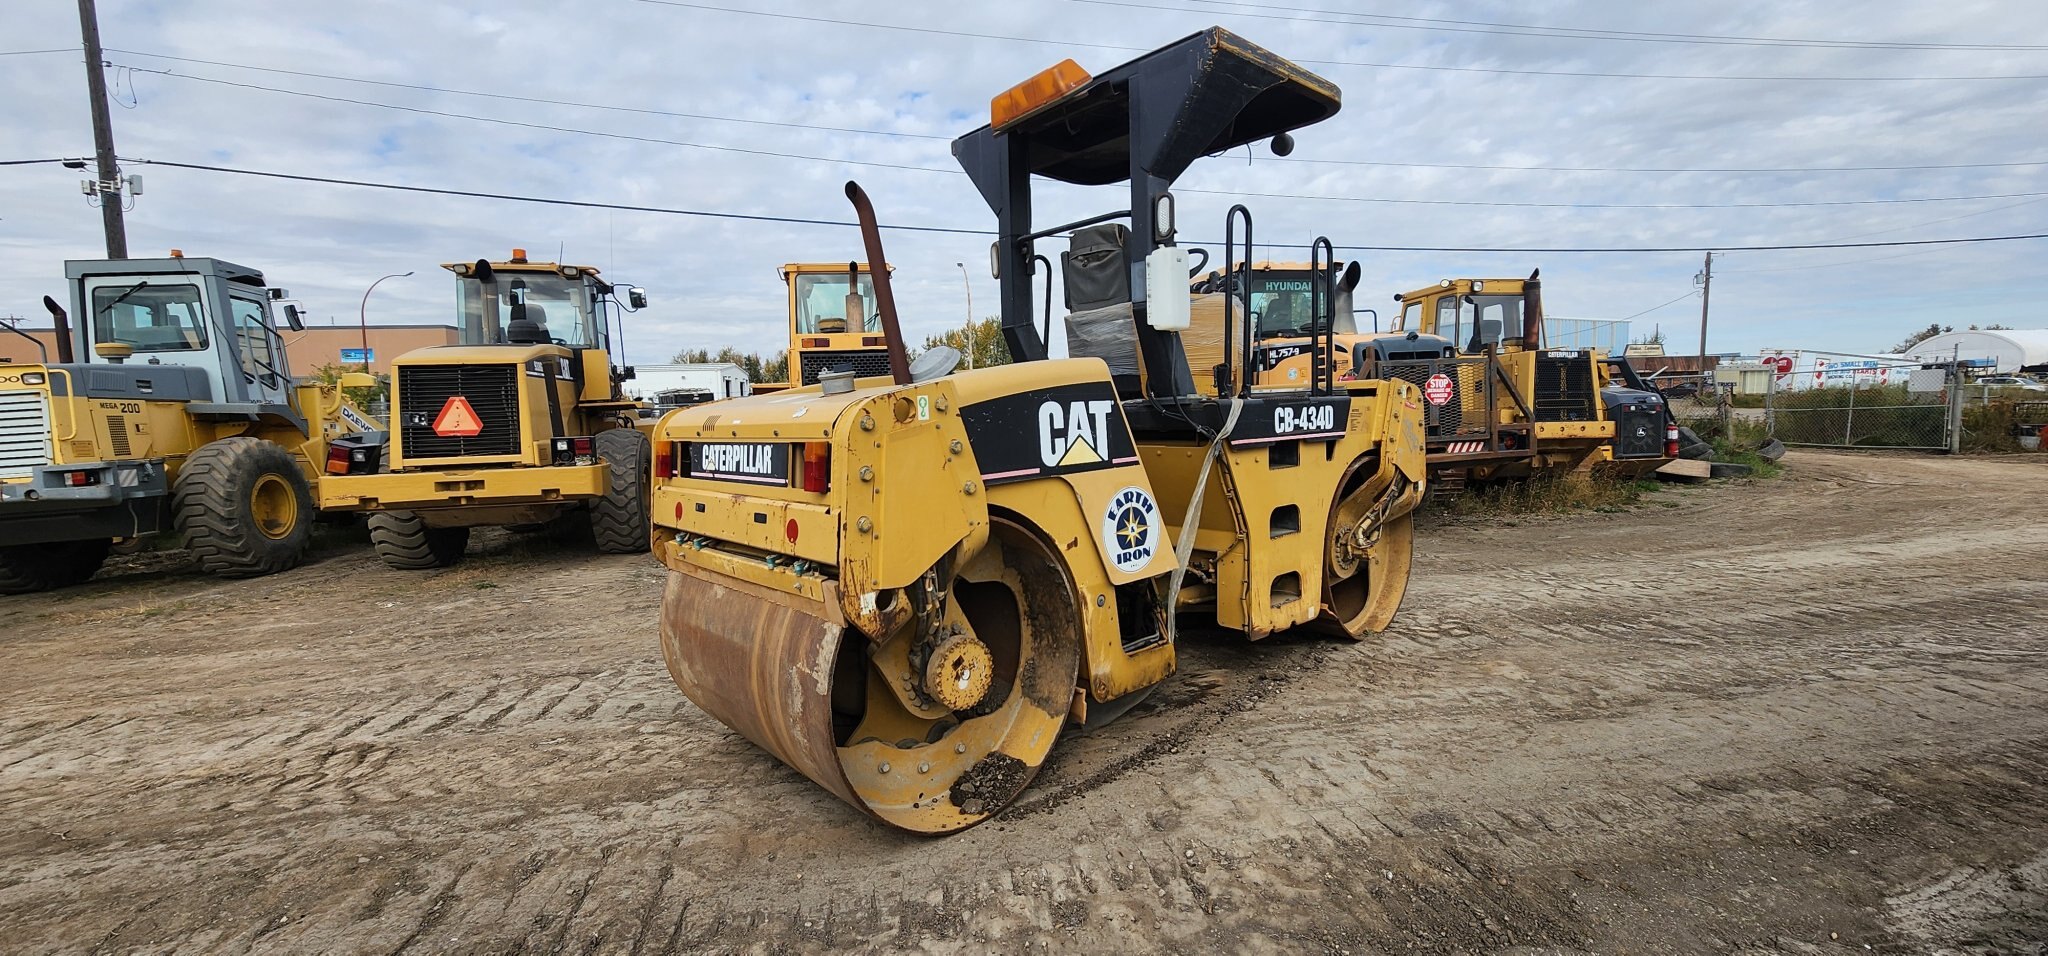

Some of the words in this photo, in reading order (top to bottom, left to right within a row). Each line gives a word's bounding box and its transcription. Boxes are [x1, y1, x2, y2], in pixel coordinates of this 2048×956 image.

[1265, 281, 1312, 291] HYUNDAI
[1269, 347, 1300, 359] HL757-9
[1547, 351, 1579, 359] CATERPILLAR
[1862, 360, 1879, 368] MEN
[1430, 378, 1449, 388] STOP
[99, 402, 119, 410] MEGA
[119, 403, 140, 414] 200
[1274, 405, 1334, 434] CB-434D
[1038, 400, 1112, 467] CAT
[702, 444, 772, 474] CATERPILLAR
[1107, 490, 1154, 522] EARTH
[1116, 546, 1151, 565] IRON
